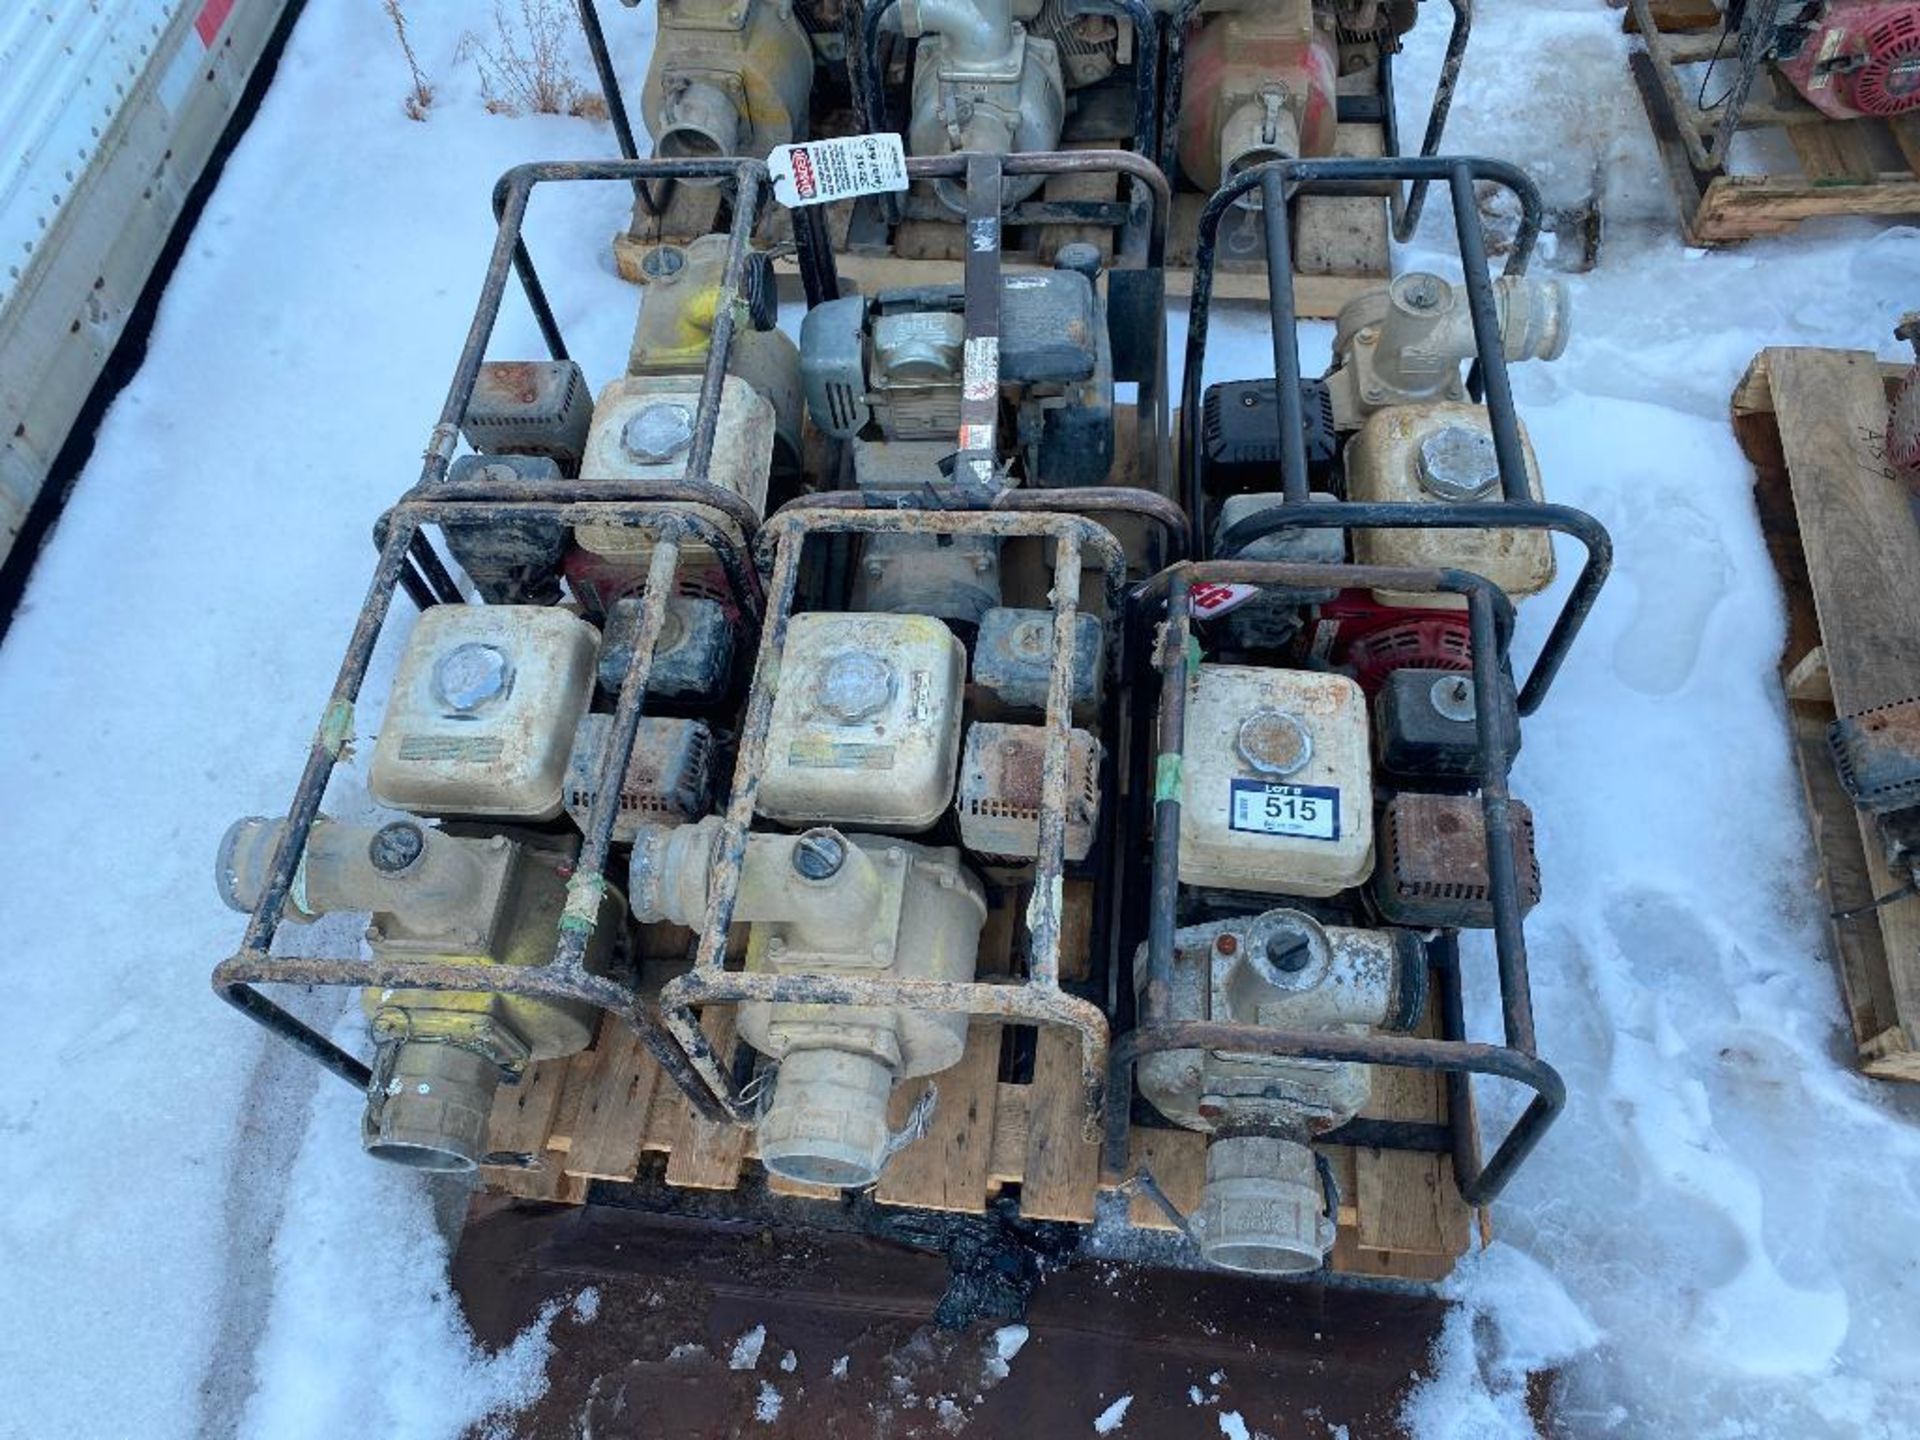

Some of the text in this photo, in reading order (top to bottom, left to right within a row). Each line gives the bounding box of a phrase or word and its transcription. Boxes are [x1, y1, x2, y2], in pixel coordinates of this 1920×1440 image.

[792, 147, 815, 198] DANGER
[1265, 784, 1289, 795] LOT
[1264, 796, 1317, 822] 515
